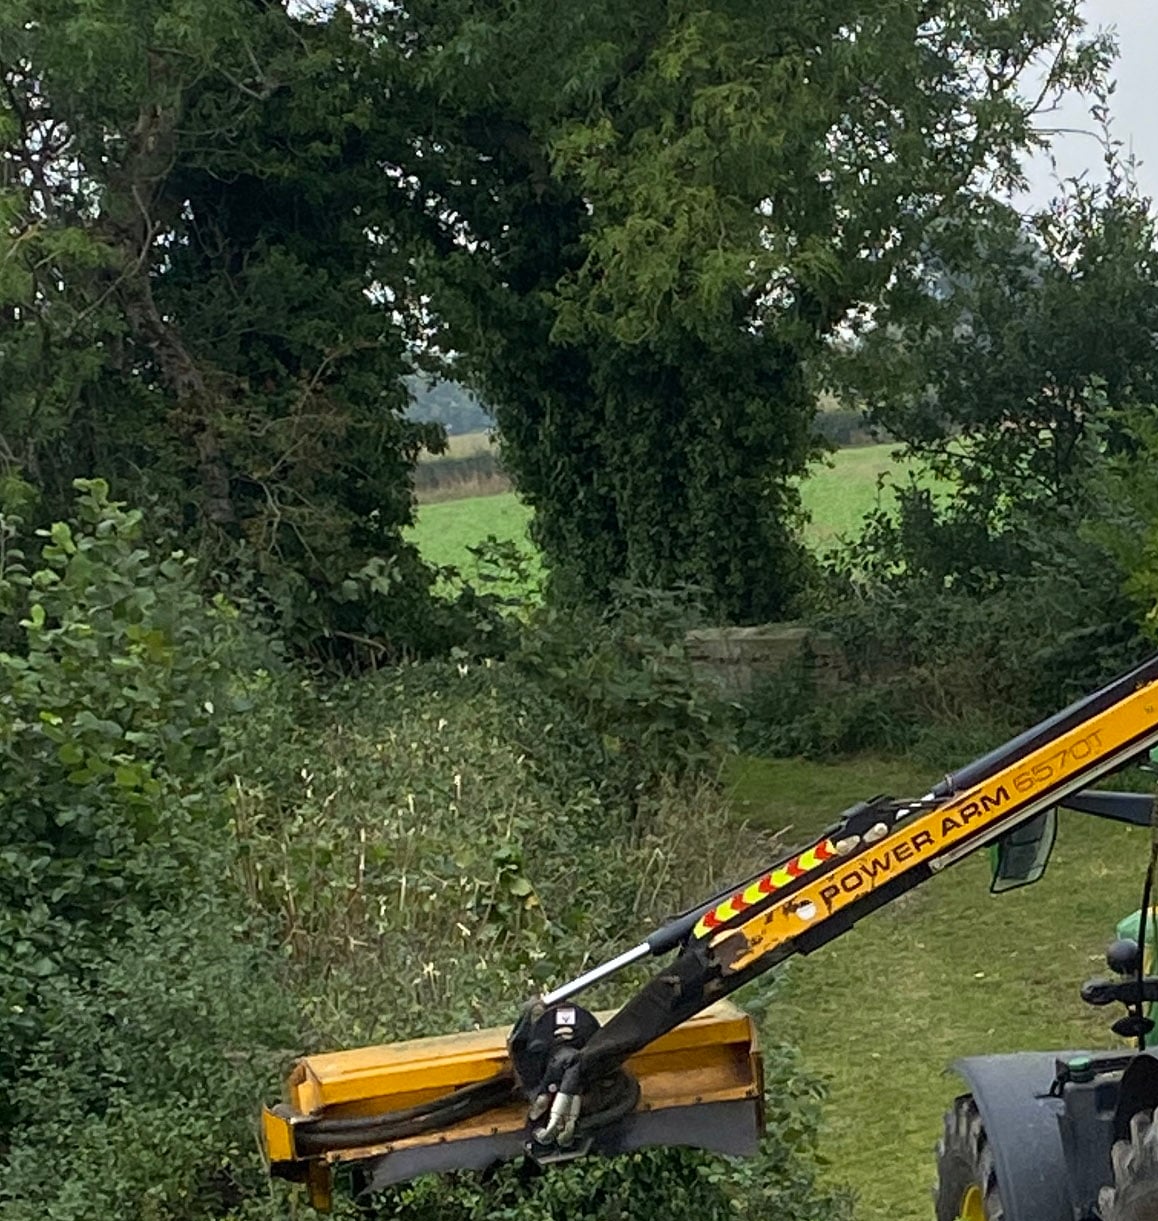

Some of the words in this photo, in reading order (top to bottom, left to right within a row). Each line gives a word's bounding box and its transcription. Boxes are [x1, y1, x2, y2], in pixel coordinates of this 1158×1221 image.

[819, 830, 935, 905] POWER
[941, 785, 1011, 837] ARM
[1013, 730, 1104, 794] 6570T
